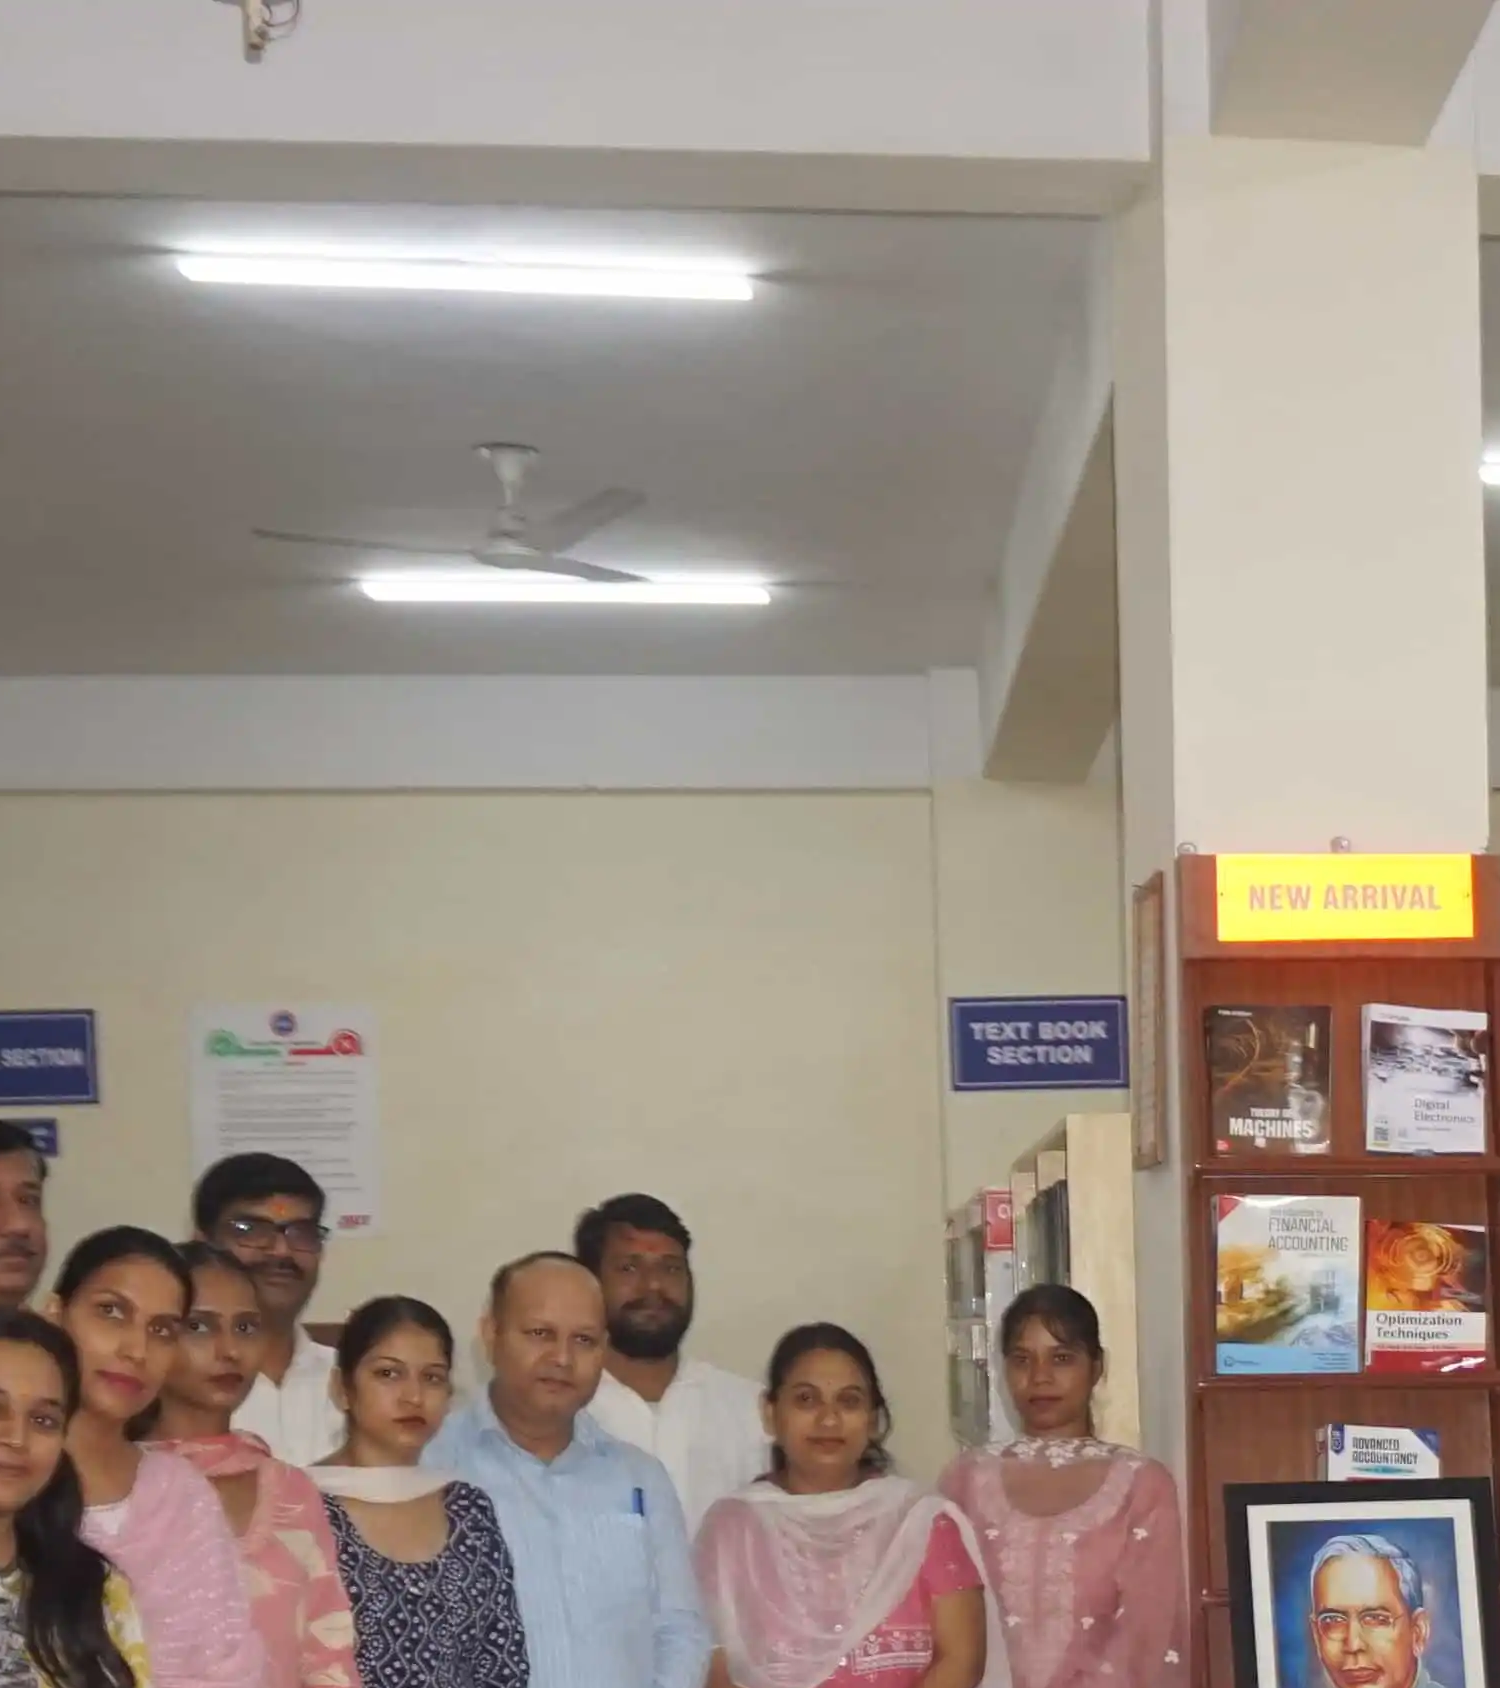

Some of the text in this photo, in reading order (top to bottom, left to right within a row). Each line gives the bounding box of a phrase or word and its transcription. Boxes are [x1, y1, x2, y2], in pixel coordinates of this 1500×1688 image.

[1248, 883, 1442, 910] NEW ARRIVAL
[968, 1020, 1107, 1041] TEXT BOOK
[0, 1047, 84, 1068] SECTION
[986, 1044, 1093, 1065] SECTION
[1414, 1097, 1450, 1111] Digital
[1414, 1110, 1476, 1125] Electronics
[1229, 1116, 1314, 1138] MACHINES
[1268, 1216, 1338, 1234] FINANCIAL
[1267, 1234, 1349, 1252] ACCOUNTING
[1376, 1312, 1463, 1327] Optimization
[1376, 1327, 1449, 1341] Techniques
[1352, 1436, 1400, 1451] ADVANCED
[1351, 1450, 1419, 1465] ACCOUNTANCY
